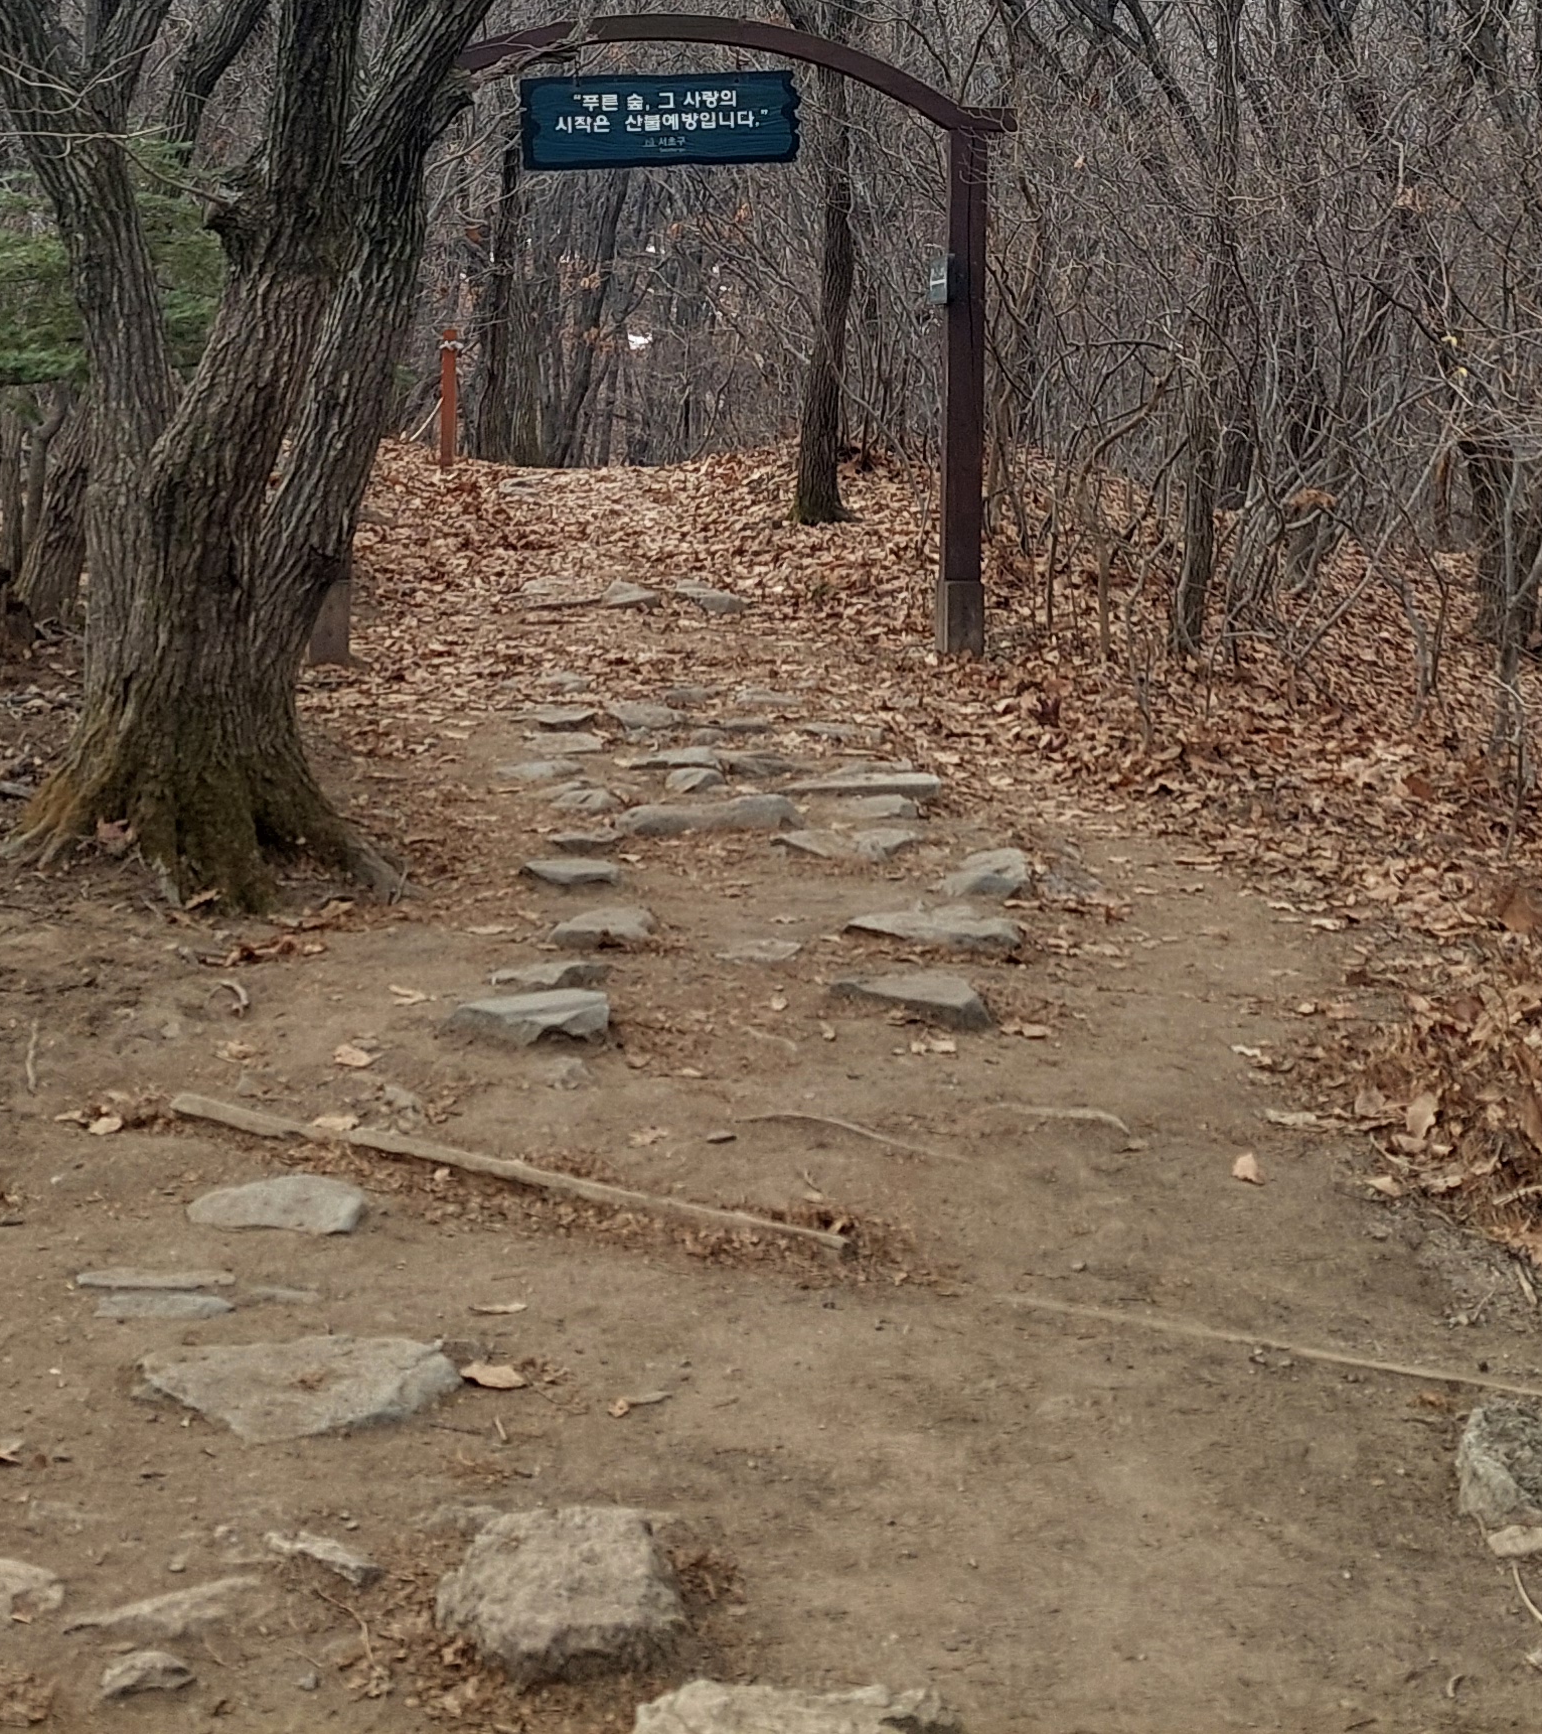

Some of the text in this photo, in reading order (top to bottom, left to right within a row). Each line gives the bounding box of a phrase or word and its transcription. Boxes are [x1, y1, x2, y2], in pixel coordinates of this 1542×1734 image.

[626, 93, 650, 112] 숲,
[658, 92, 676, 109] 그
[683, 89, 737, 109] 사랑의
[555, 116, 611, 133] 시작은
